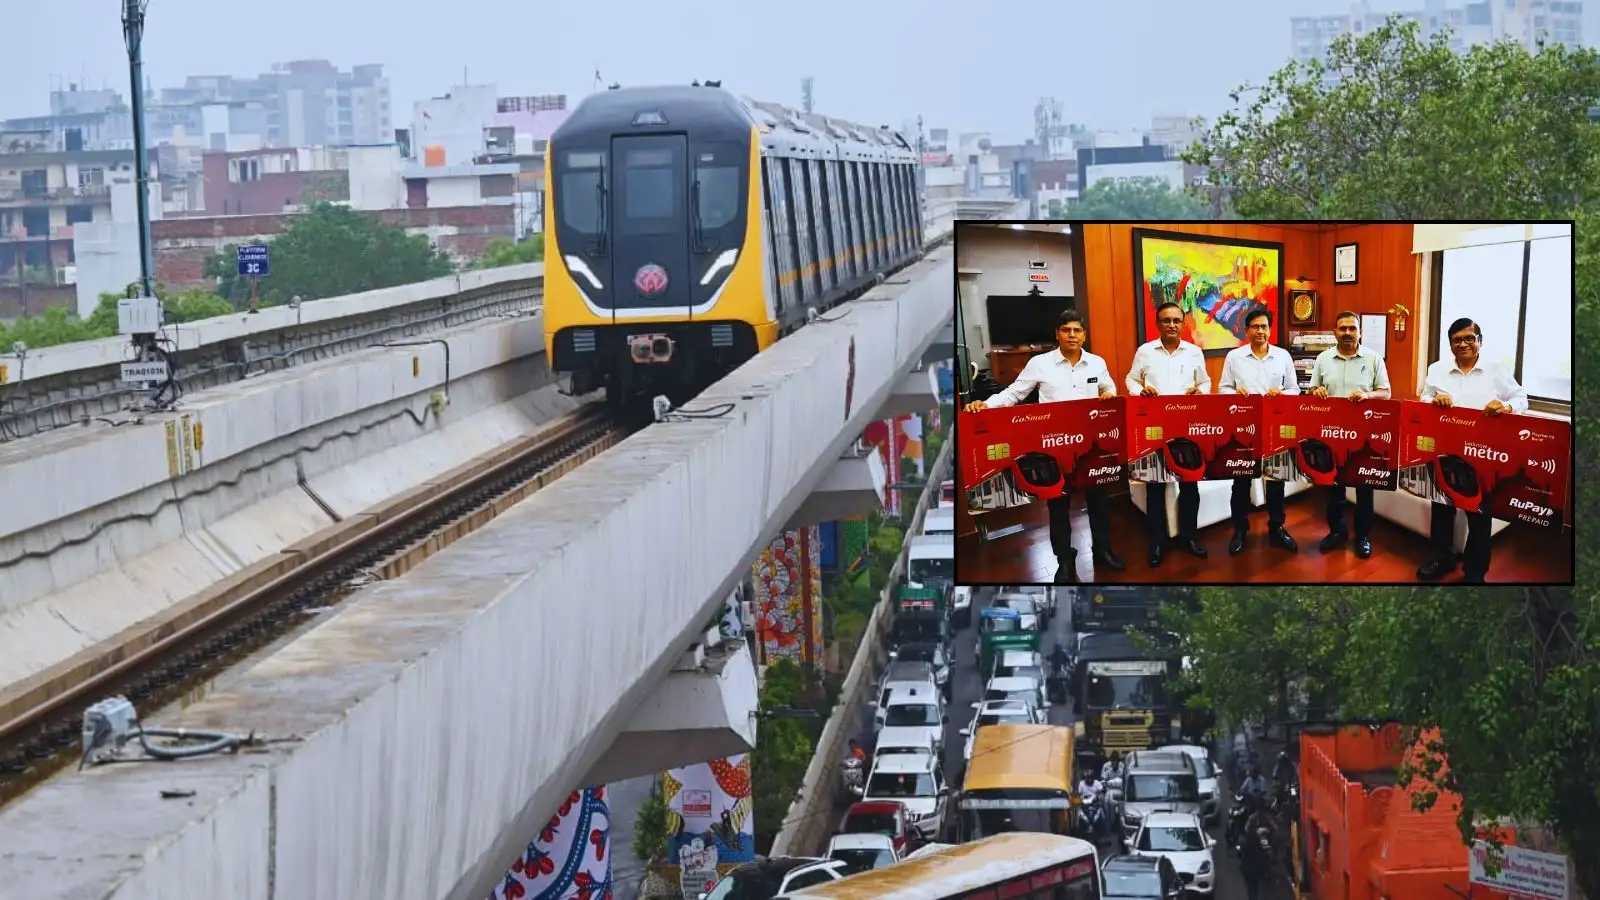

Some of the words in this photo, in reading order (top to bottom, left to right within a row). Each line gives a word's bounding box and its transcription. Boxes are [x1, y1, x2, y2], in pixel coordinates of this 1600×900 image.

[1165, 403, 1198, 411] GoSmart
[1299, 403, 1331, 412] GoSmart
[1012, 413, 1051, 424] GoSmart
[1439, 414, 1477, 427] GoSmart
[1188, 425, 1224, 435] metro
[1321, 427, 1357, 440] metro
[1042, 433, 1084, 448] metro
[1464, 440, 1488, 449] Lucknow
[1463, 445, 1509, 463] metro
[1226, 459, 1252, 468] RuPay
[1088, 466, 1118, 477] RuPay
[1358, 467, 1387, 478] RuPay
[1509, 497, 1550, 517] RuPay
[1518, 514, 1550, 527] PREPAID
